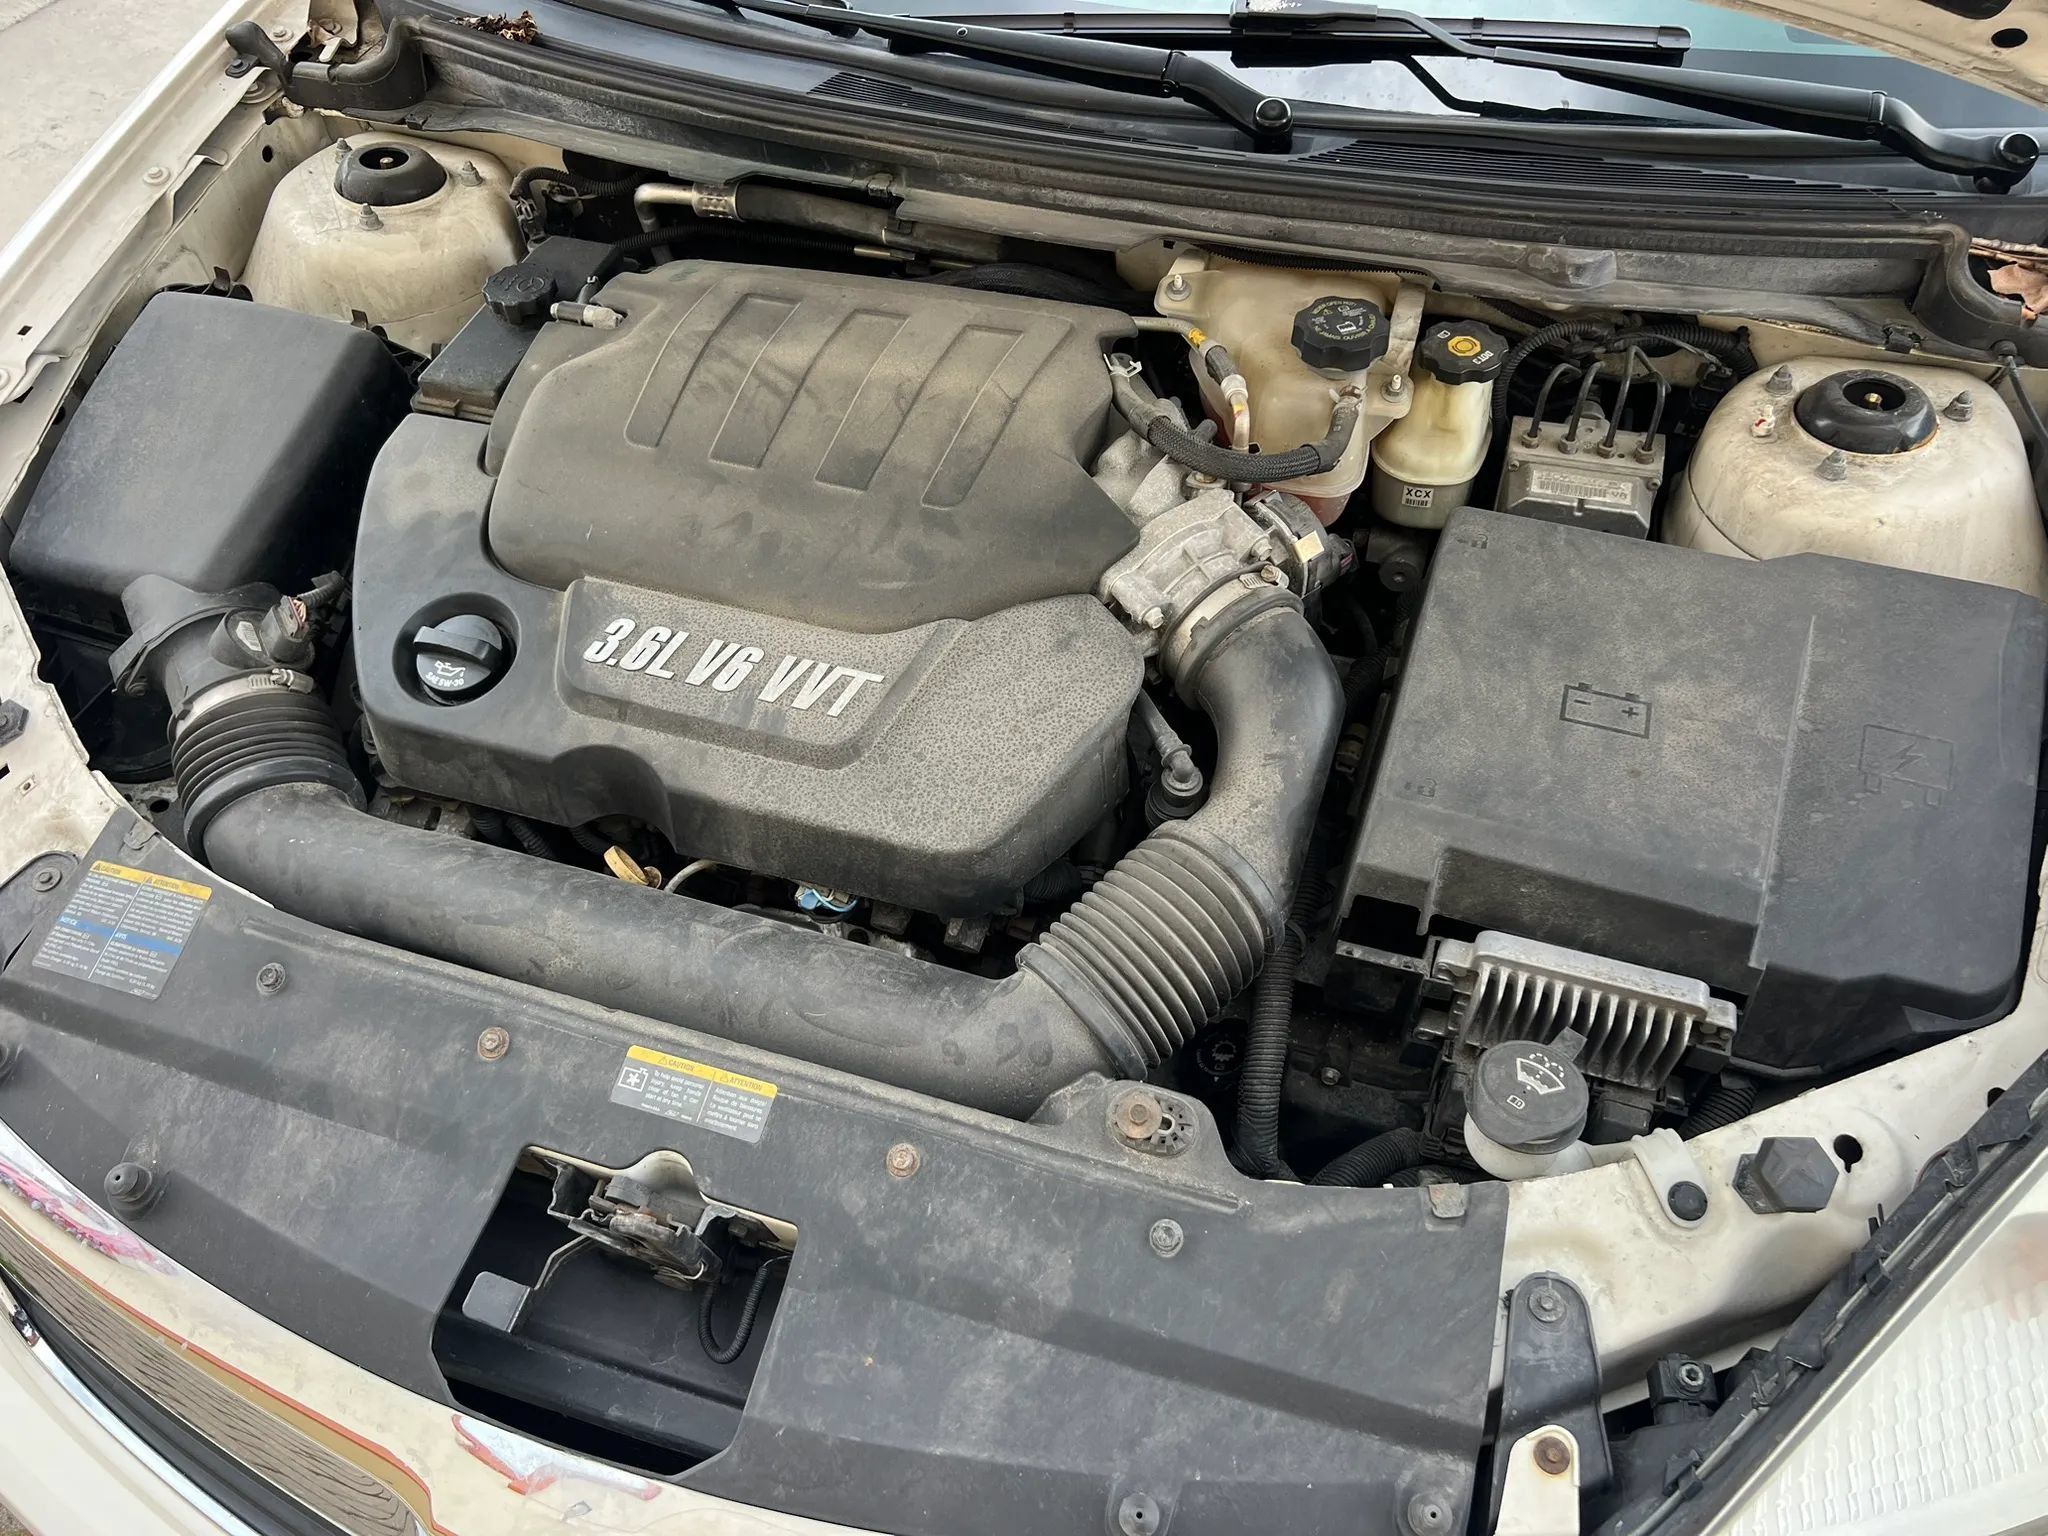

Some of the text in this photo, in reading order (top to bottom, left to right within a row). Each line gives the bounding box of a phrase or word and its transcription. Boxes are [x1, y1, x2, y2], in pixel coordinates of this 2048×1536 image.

[1406, 488, 1432, 498] XCX
[583, 617, 885, 718] 3.6L V6 VVT
[426, 672, 440, 684] SAE
[669, 1060, 695, 1072] CAUTION
[660, 1072, 670, 1080] help
[671, 1076, 684, 1084] avoid
[728, 1076, 762, 1092] ATTENTION
